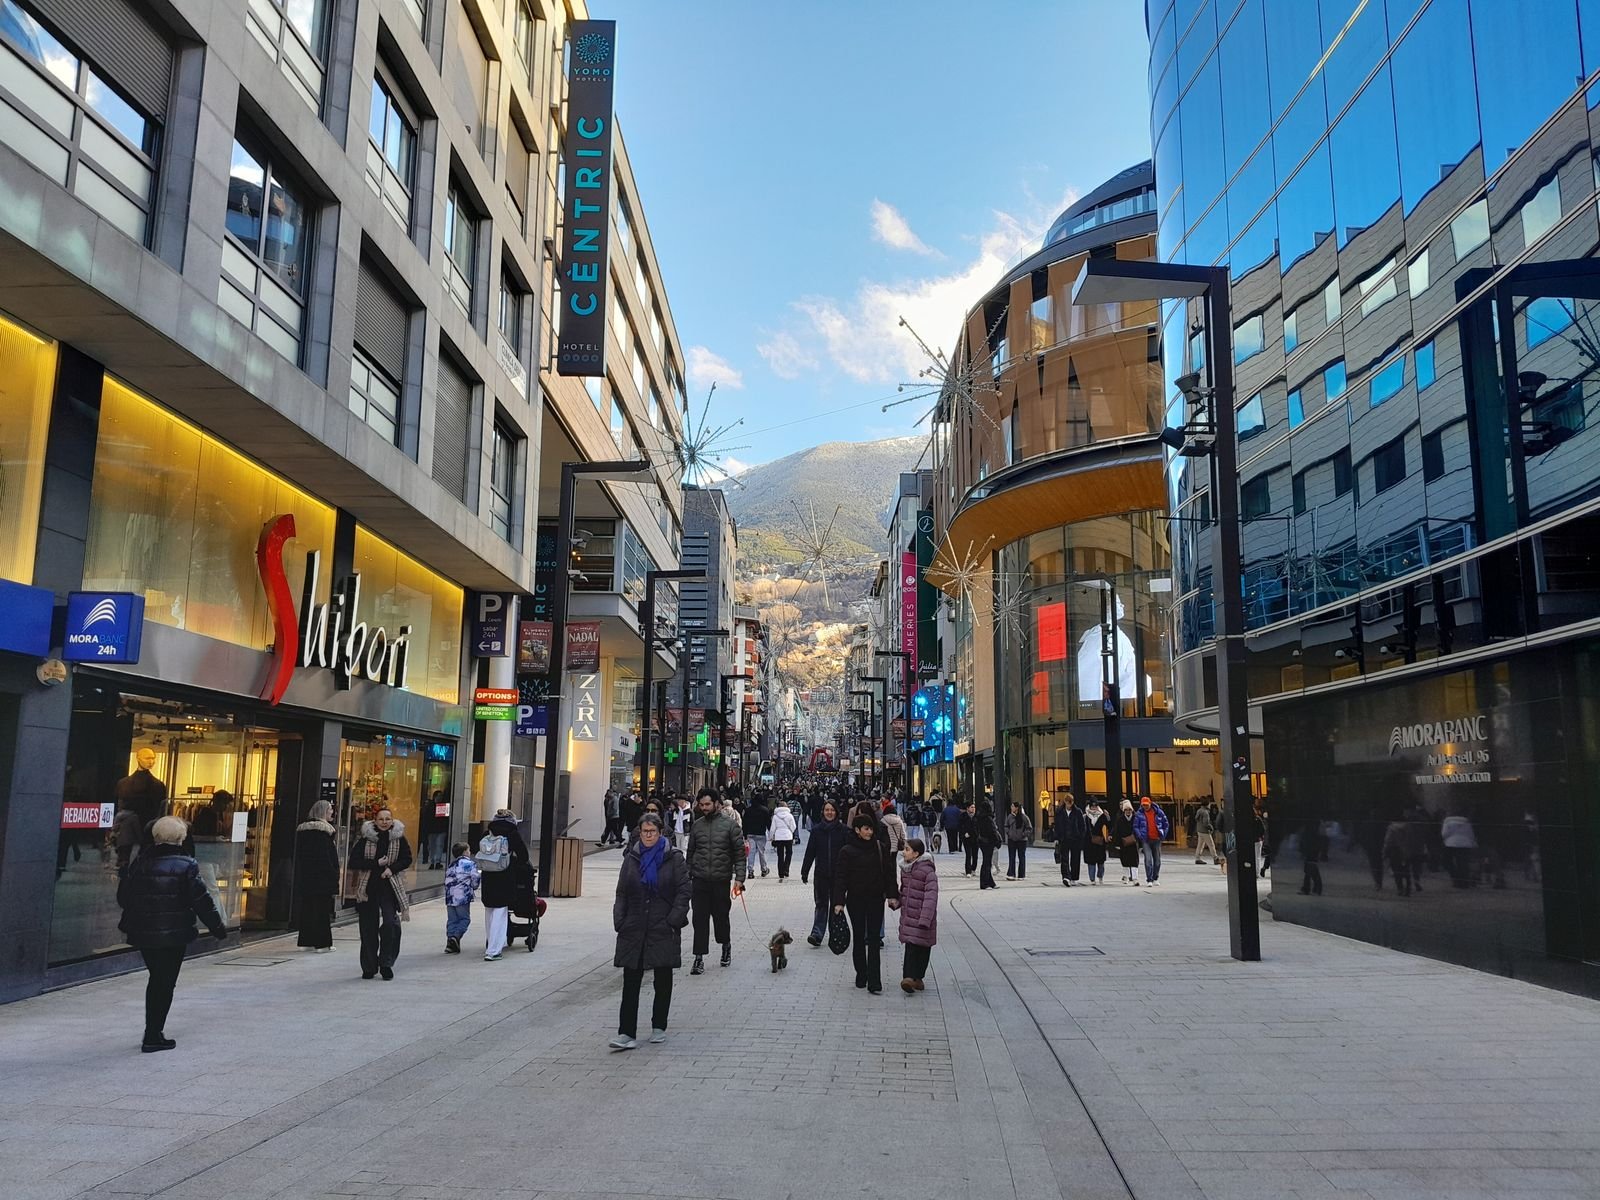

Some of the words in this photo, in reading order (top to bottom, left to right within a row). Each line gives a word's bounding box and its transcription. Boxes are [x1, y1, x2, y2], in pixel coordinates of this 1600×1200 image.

[574, 68, 610, 76] YOMO
[566, 116, 604, 316] CÈNTRIC
[563, 343, 599, 351] HOTEL
[258, 514, 413, 706] Shibori
[480, 594, 503, 622] P
[69, 634, 125, 644] MORABANC
[568, 632, 599, 643] NADAL
[97, 644, 117, 656] 24h
[575, 674, 597, 738] ZARA
[516, 705, 534, 726] P
[1402, 715, 1488, 748] MORABANC
[1173, 738, 1200, 746] Massimo
[1202, 737, 1219, 746] Dutti
[63, 807, 99, 823] REBAIXES
